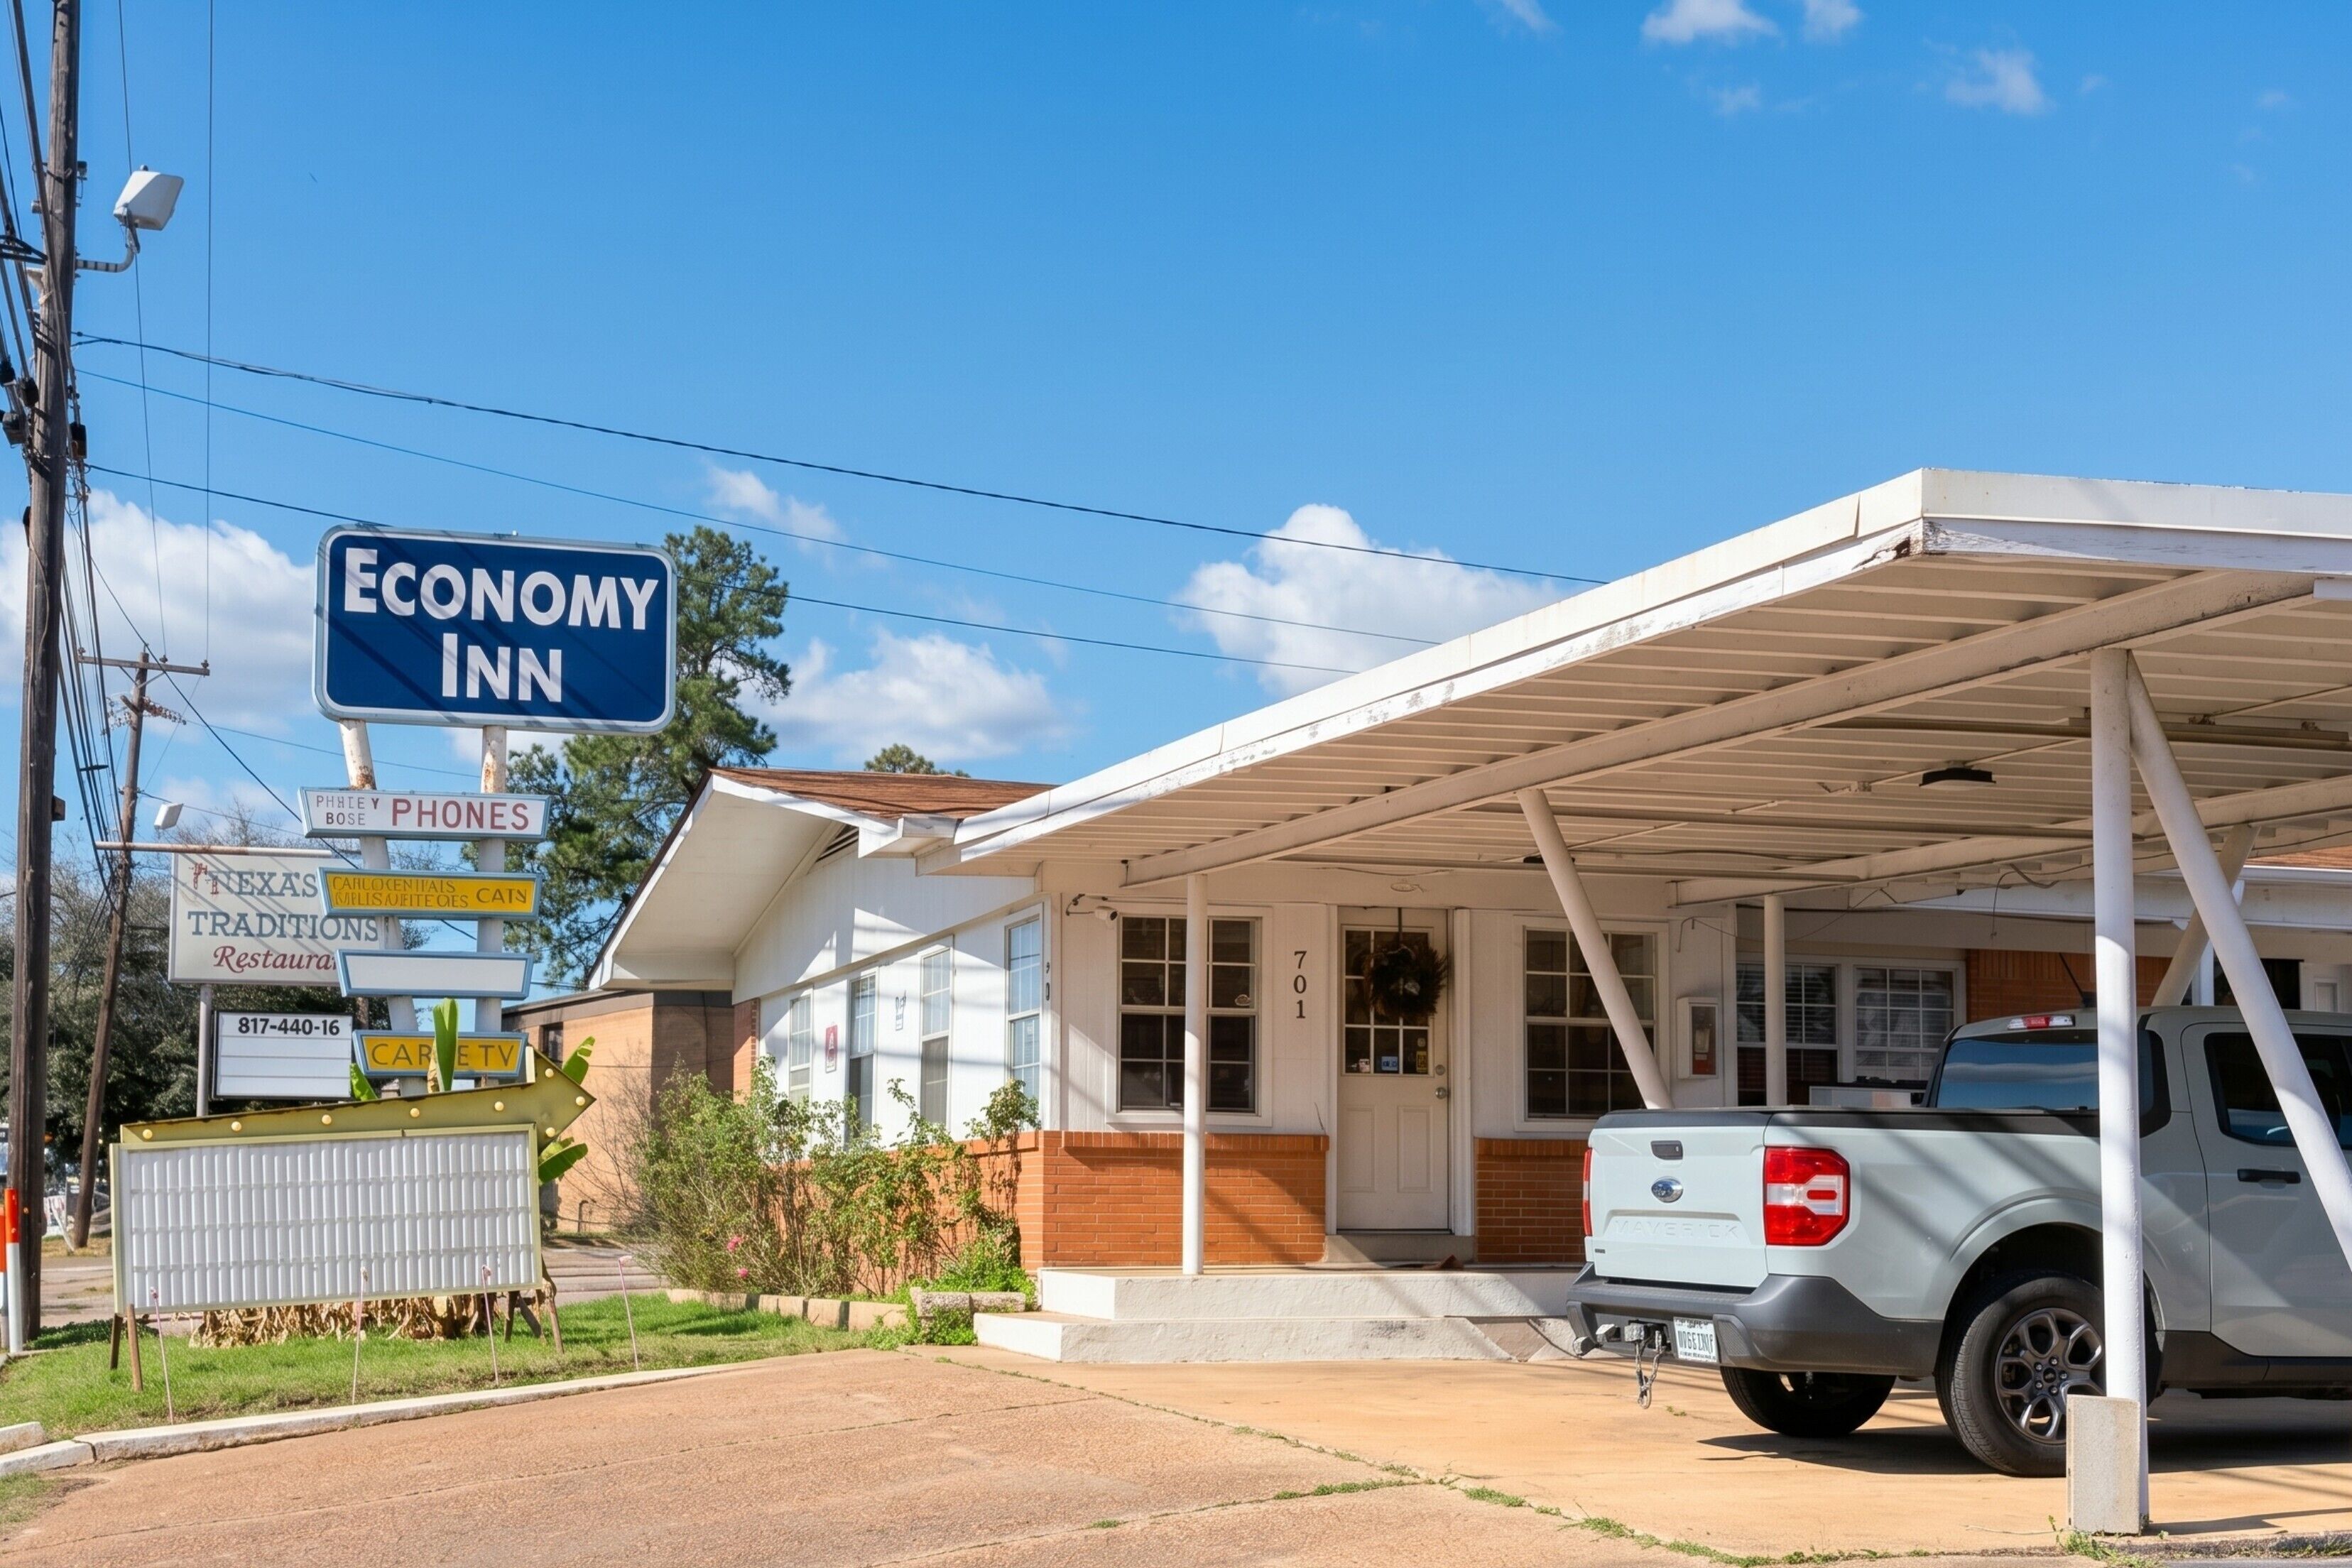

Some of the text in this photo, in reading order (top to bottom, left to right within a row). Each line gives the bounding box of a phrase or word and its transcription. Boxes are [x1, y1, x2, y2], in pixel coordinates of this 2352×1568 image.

[344, 548, 659, 631] ECONOMY
[442, 633, 562, 702] INN
[392, 798, 529, 830] PHONES
[187, 910, 379, 942] TRADITIONS
[238, 1017, 340, 1036] 817-440-16
[478, 1045, 515, 1067] TV
[1615, 1219, 1739, 1239] MAVERCK
